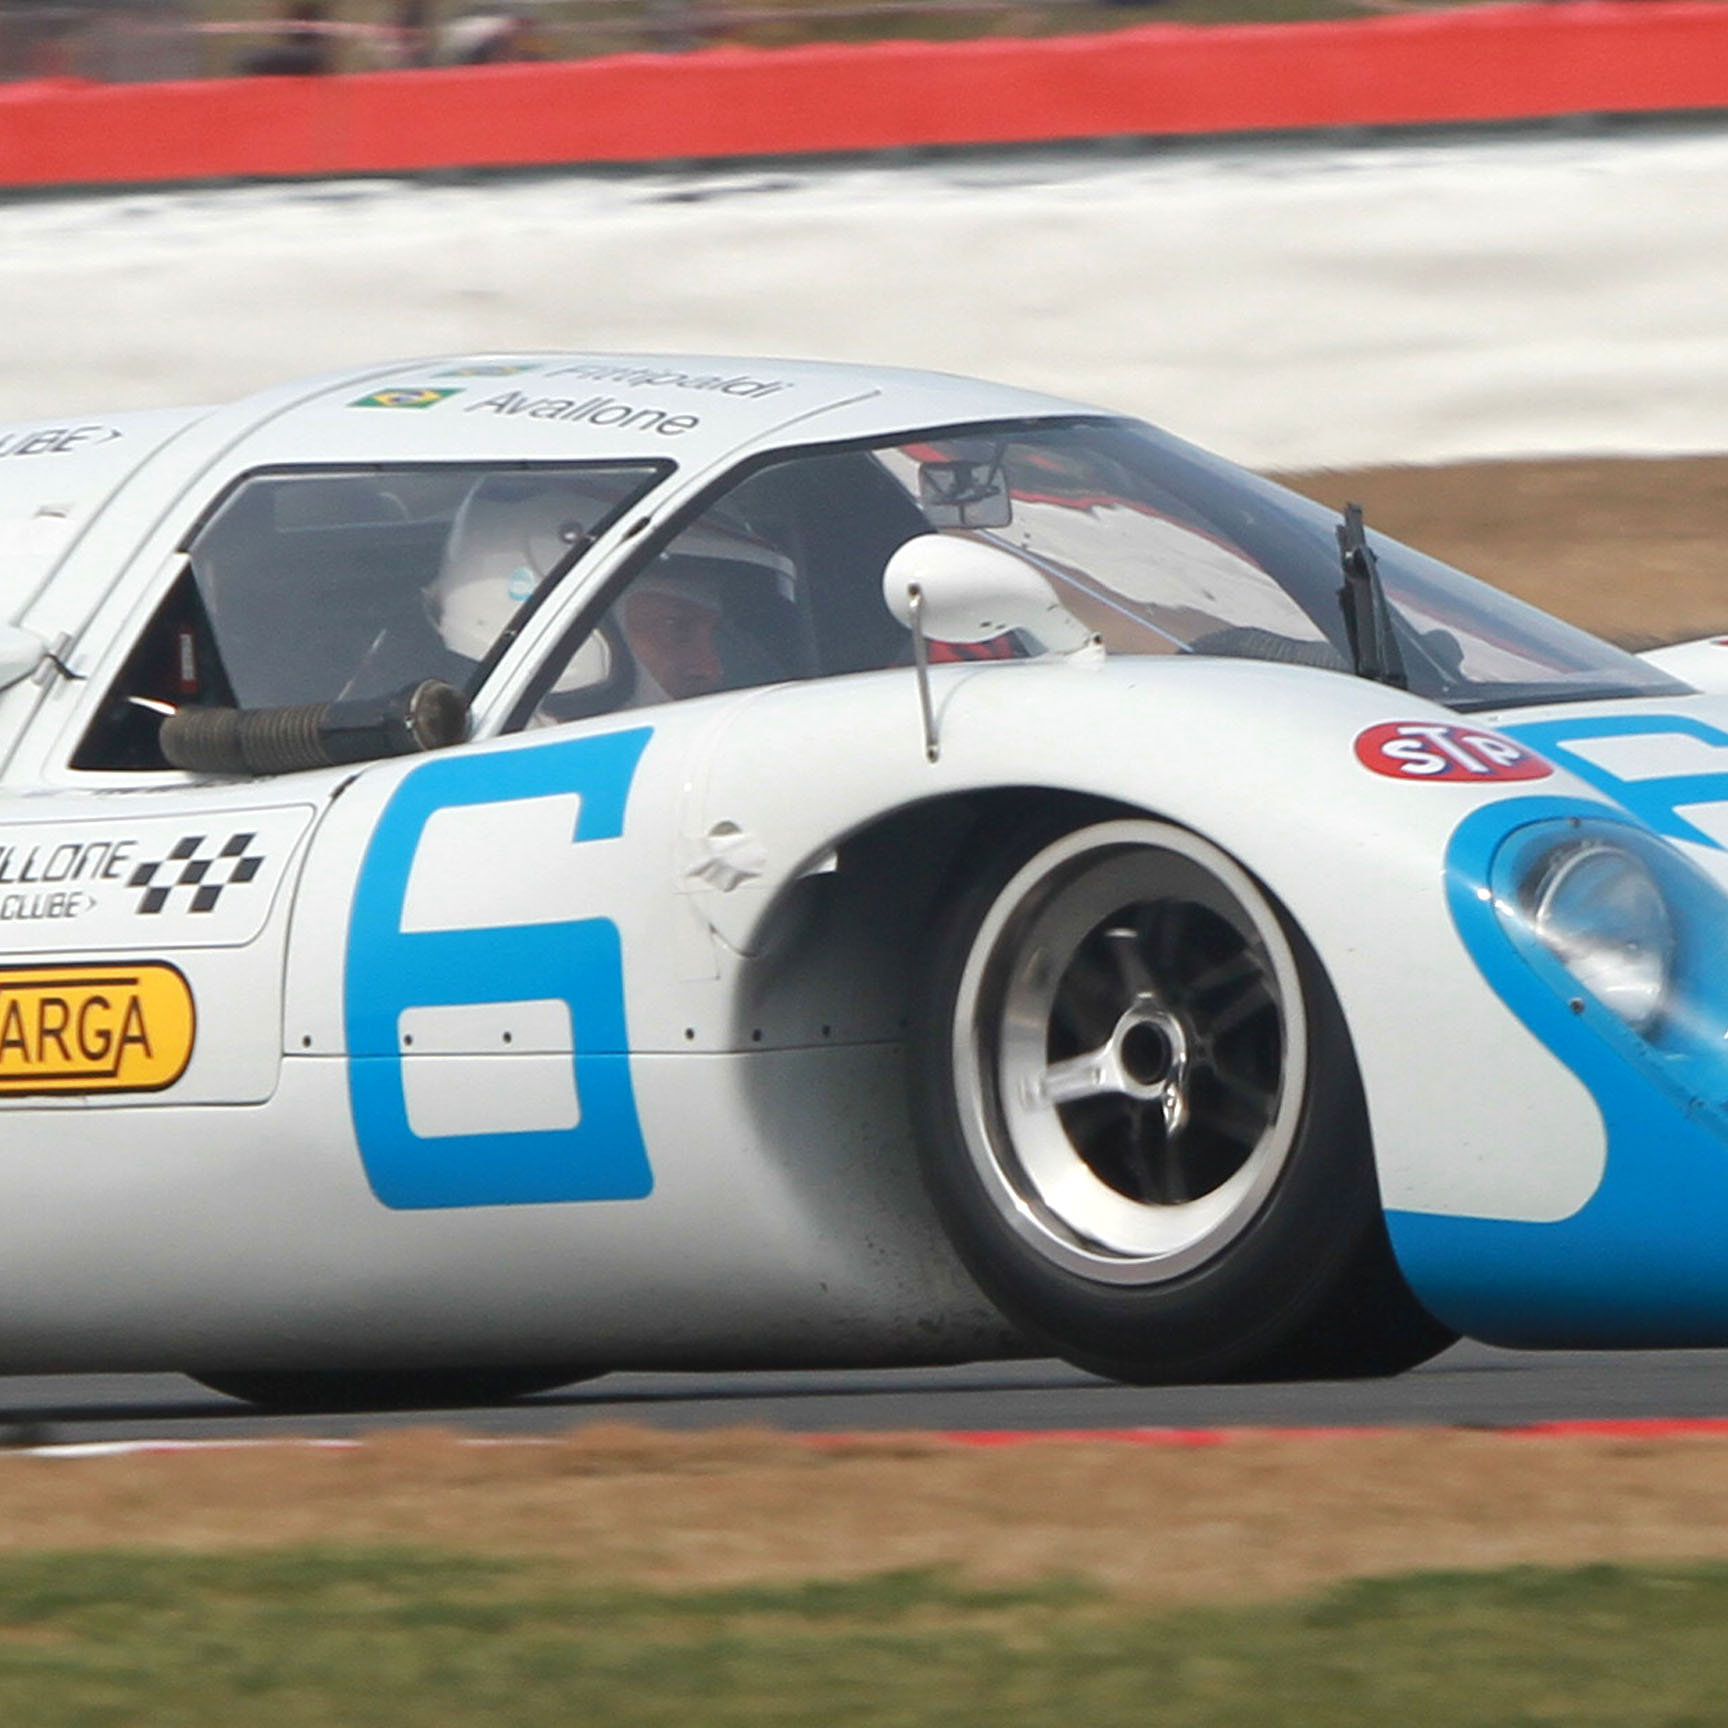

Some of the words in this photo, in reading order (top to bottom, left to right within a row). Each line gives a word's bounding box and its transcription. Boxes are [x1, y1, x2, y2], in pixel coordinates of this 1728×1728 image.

[465, 390, 700, 436] Avallone
[1381, 726, 1522, 775] STP
[345, 726, 655, 1211] 6
